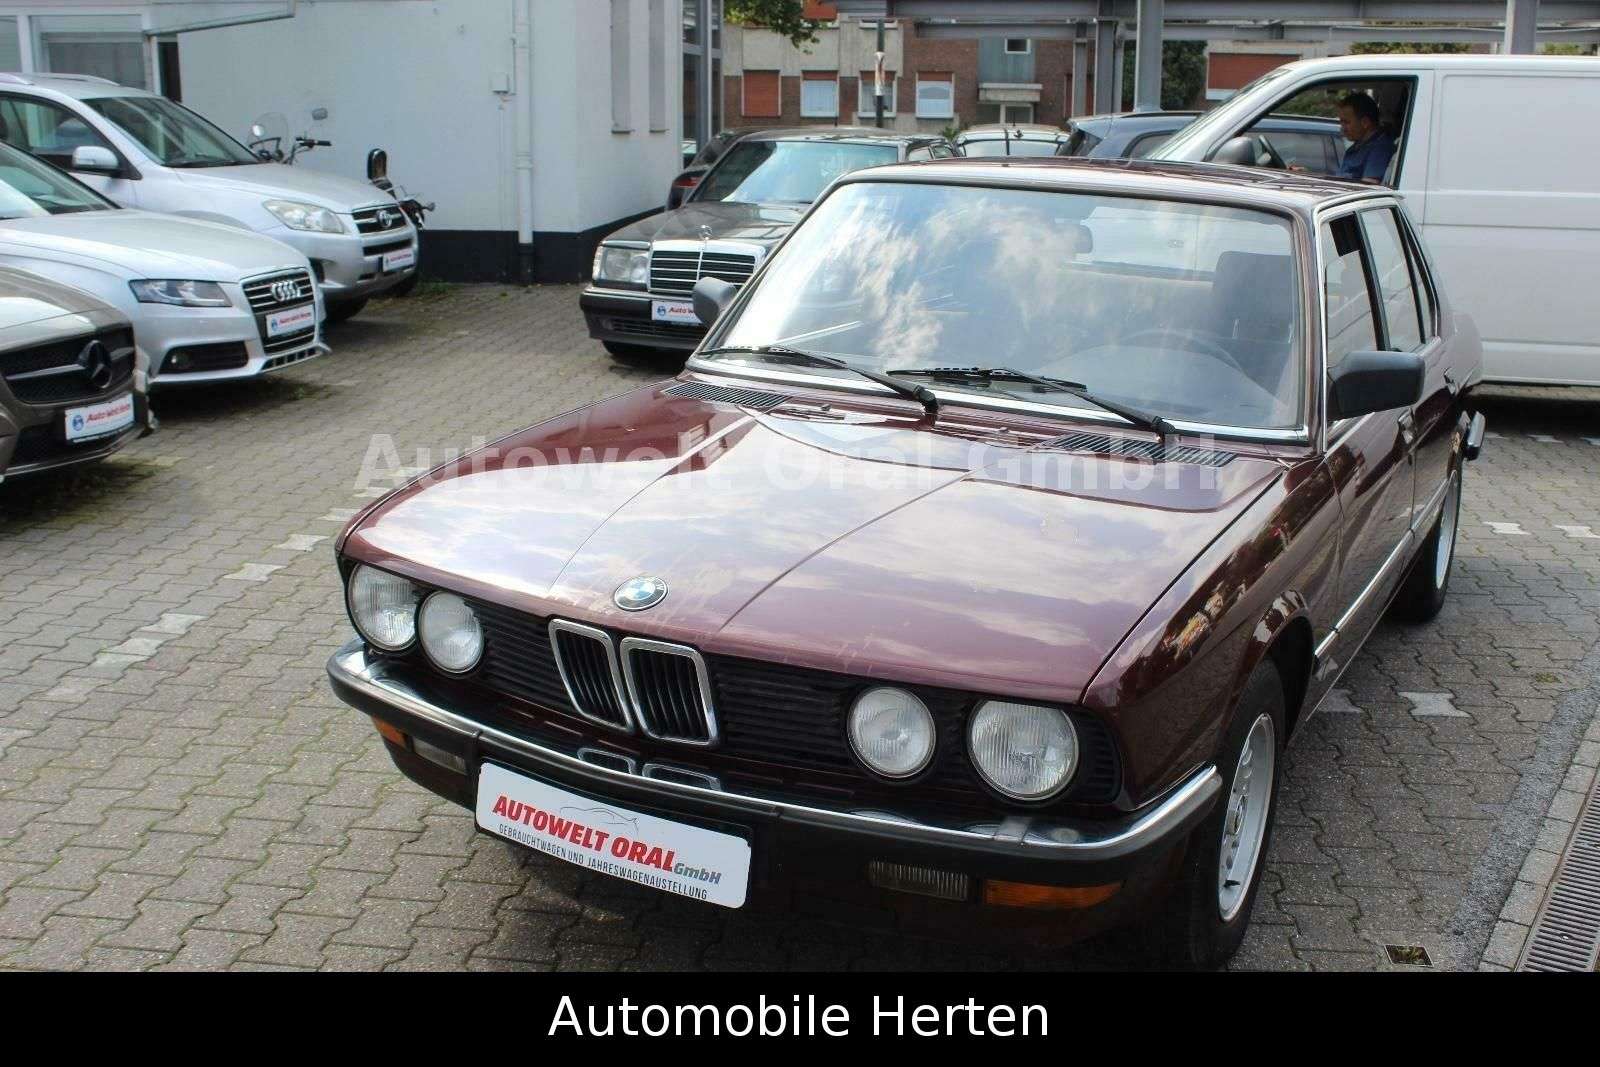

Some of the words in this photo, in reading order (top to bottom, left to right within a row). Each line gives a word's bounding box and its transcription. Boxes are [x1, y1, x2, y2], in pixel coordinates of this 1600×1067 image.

[492, 795, 610, 852] AUTOWELT
[611, 836, 675, 872] ORAL
[674, 862, 722, 885] GmbH
[499, 823, 568, 858] GEBRAUCHTWAGEN
[567, 850, 584, 865] UND
[587, 857, 708, 900] JAHRESWAGENAUSTELLUNG
